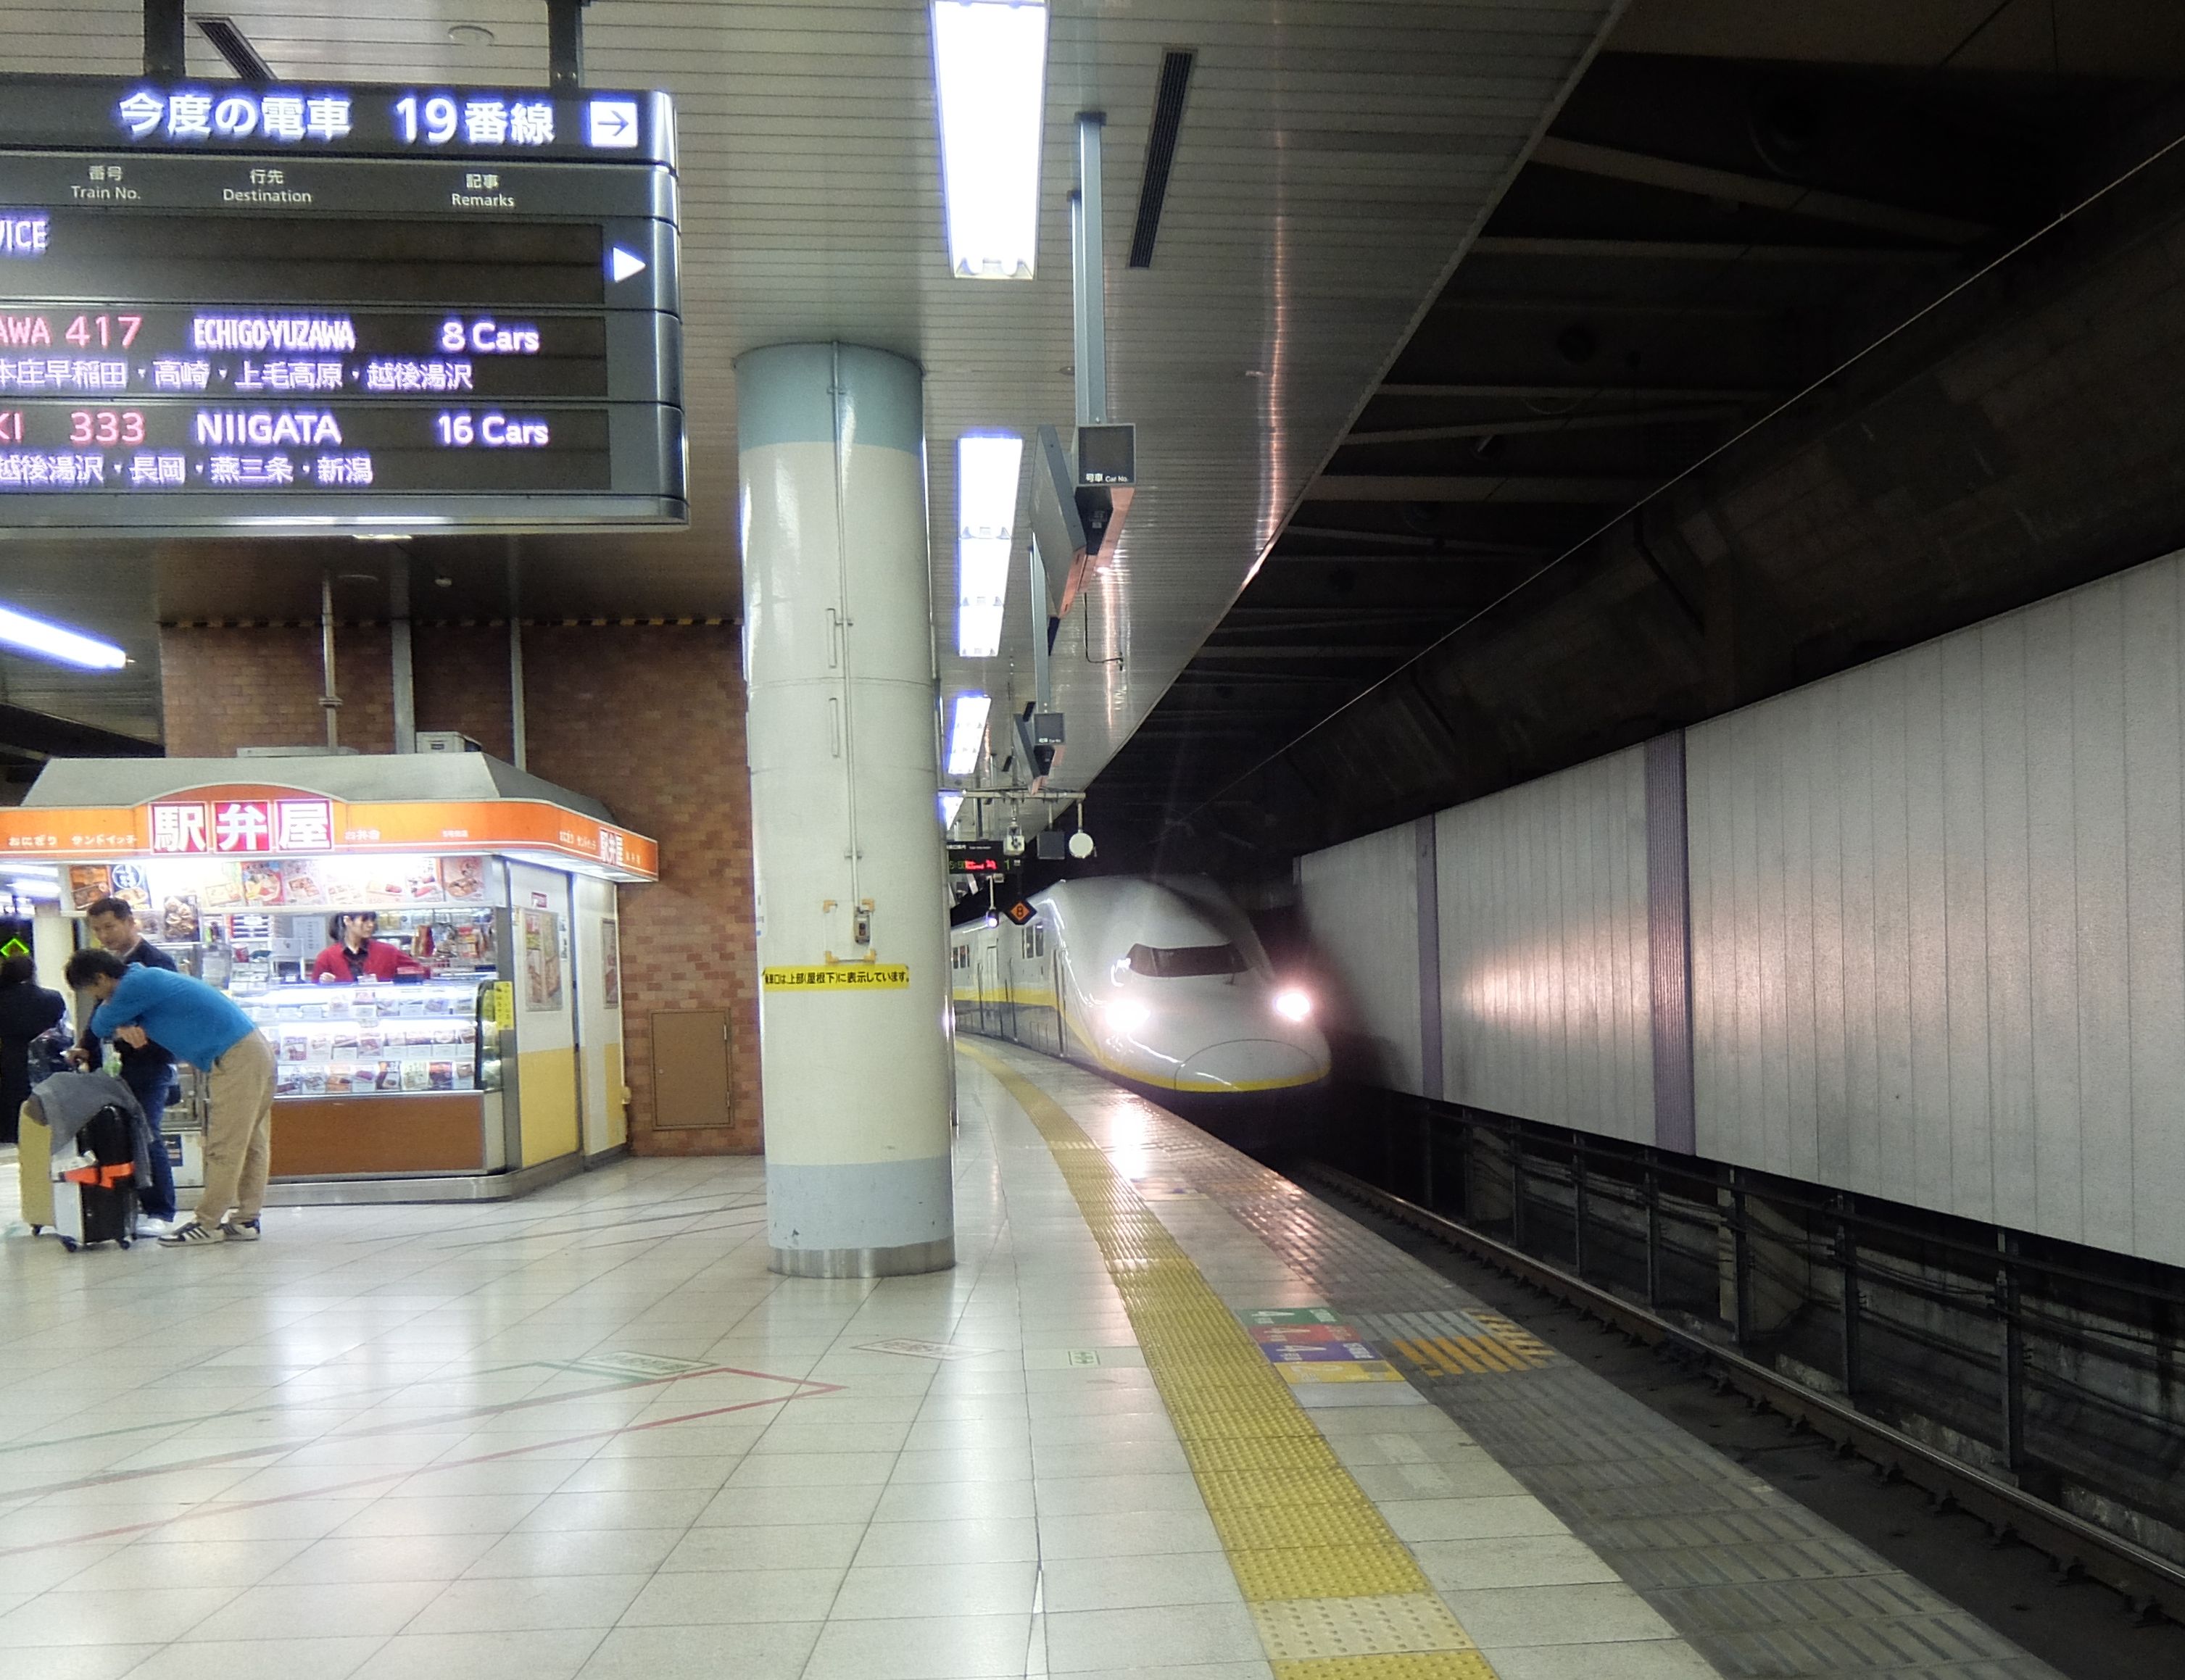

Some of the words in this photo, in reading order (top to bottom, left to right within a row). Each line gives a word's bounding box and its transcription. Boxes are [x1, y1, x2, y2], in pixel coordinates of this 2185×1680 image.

[118, 92, 351, 140] 今度の電車
[396, 97, 555, 144] 19番線
[88, 165, 122, 181] 番号
[249, 168, 284, 184] 行先
[465, 173, 499, 189] 記事
[71, 186, 109, 199] Train
[112, 186, 141, 200] No.
[223, 188, 312, 203] Destination
[452, 193, 515, 207] Remarks
[65, 316, 141, 347] 417
[194, 318, 355, 349] ECHIGO-YUZAWA
[442, 322, 465, 350] 8
[473, 323, 539, 351] Cars
[70, 412, 144, 442] 333
[196, 413, 341, 444] NIIGATA
[438, 415, 474, 444] 16
[482, 416, 549, 445] Cars
[154, 802, 330, 852] 駅弁屋
[1016, 905, 1024, 917] 8
